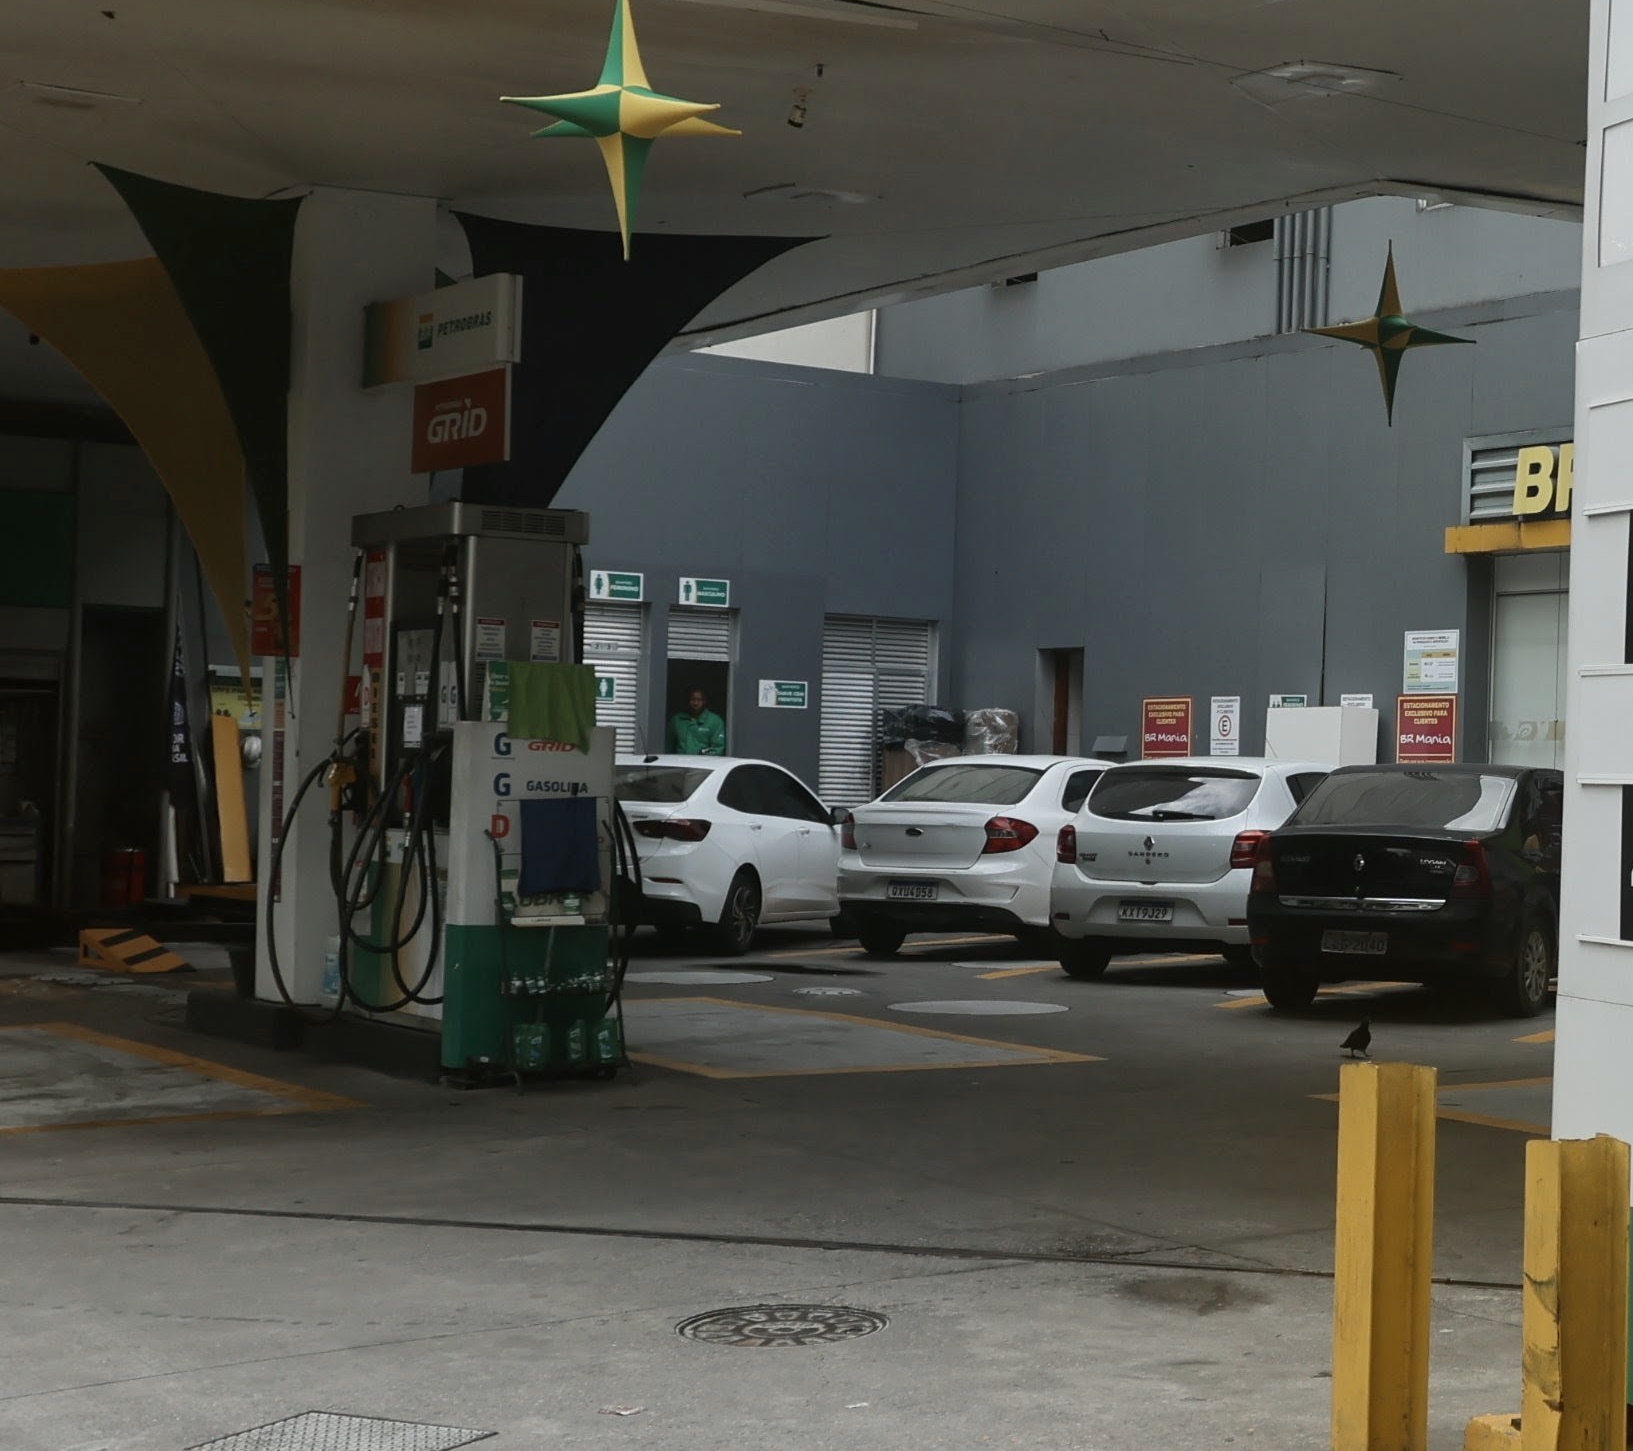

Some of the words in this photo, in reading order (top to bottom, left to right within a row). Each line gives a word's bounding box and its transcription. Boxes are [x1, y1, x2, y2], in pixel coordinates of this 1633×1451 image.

[438, 311, 492, 337] PETROBRAS
[427, 398, 487, 443] GRID
[1145, 732, 1156, 742] BR
[1157, 733, 1187, 742] Mania
[1222, 720, 1228, 732] E
[494, 732, 511, 755] G
[1400, 735, 1414, 744] BR
[1416, 734, 1451, 745] Mania
[493, 772, 511, 797] G
[526, 780, 588, 794] GASOLIA
[491, 815, 510, 838] D
